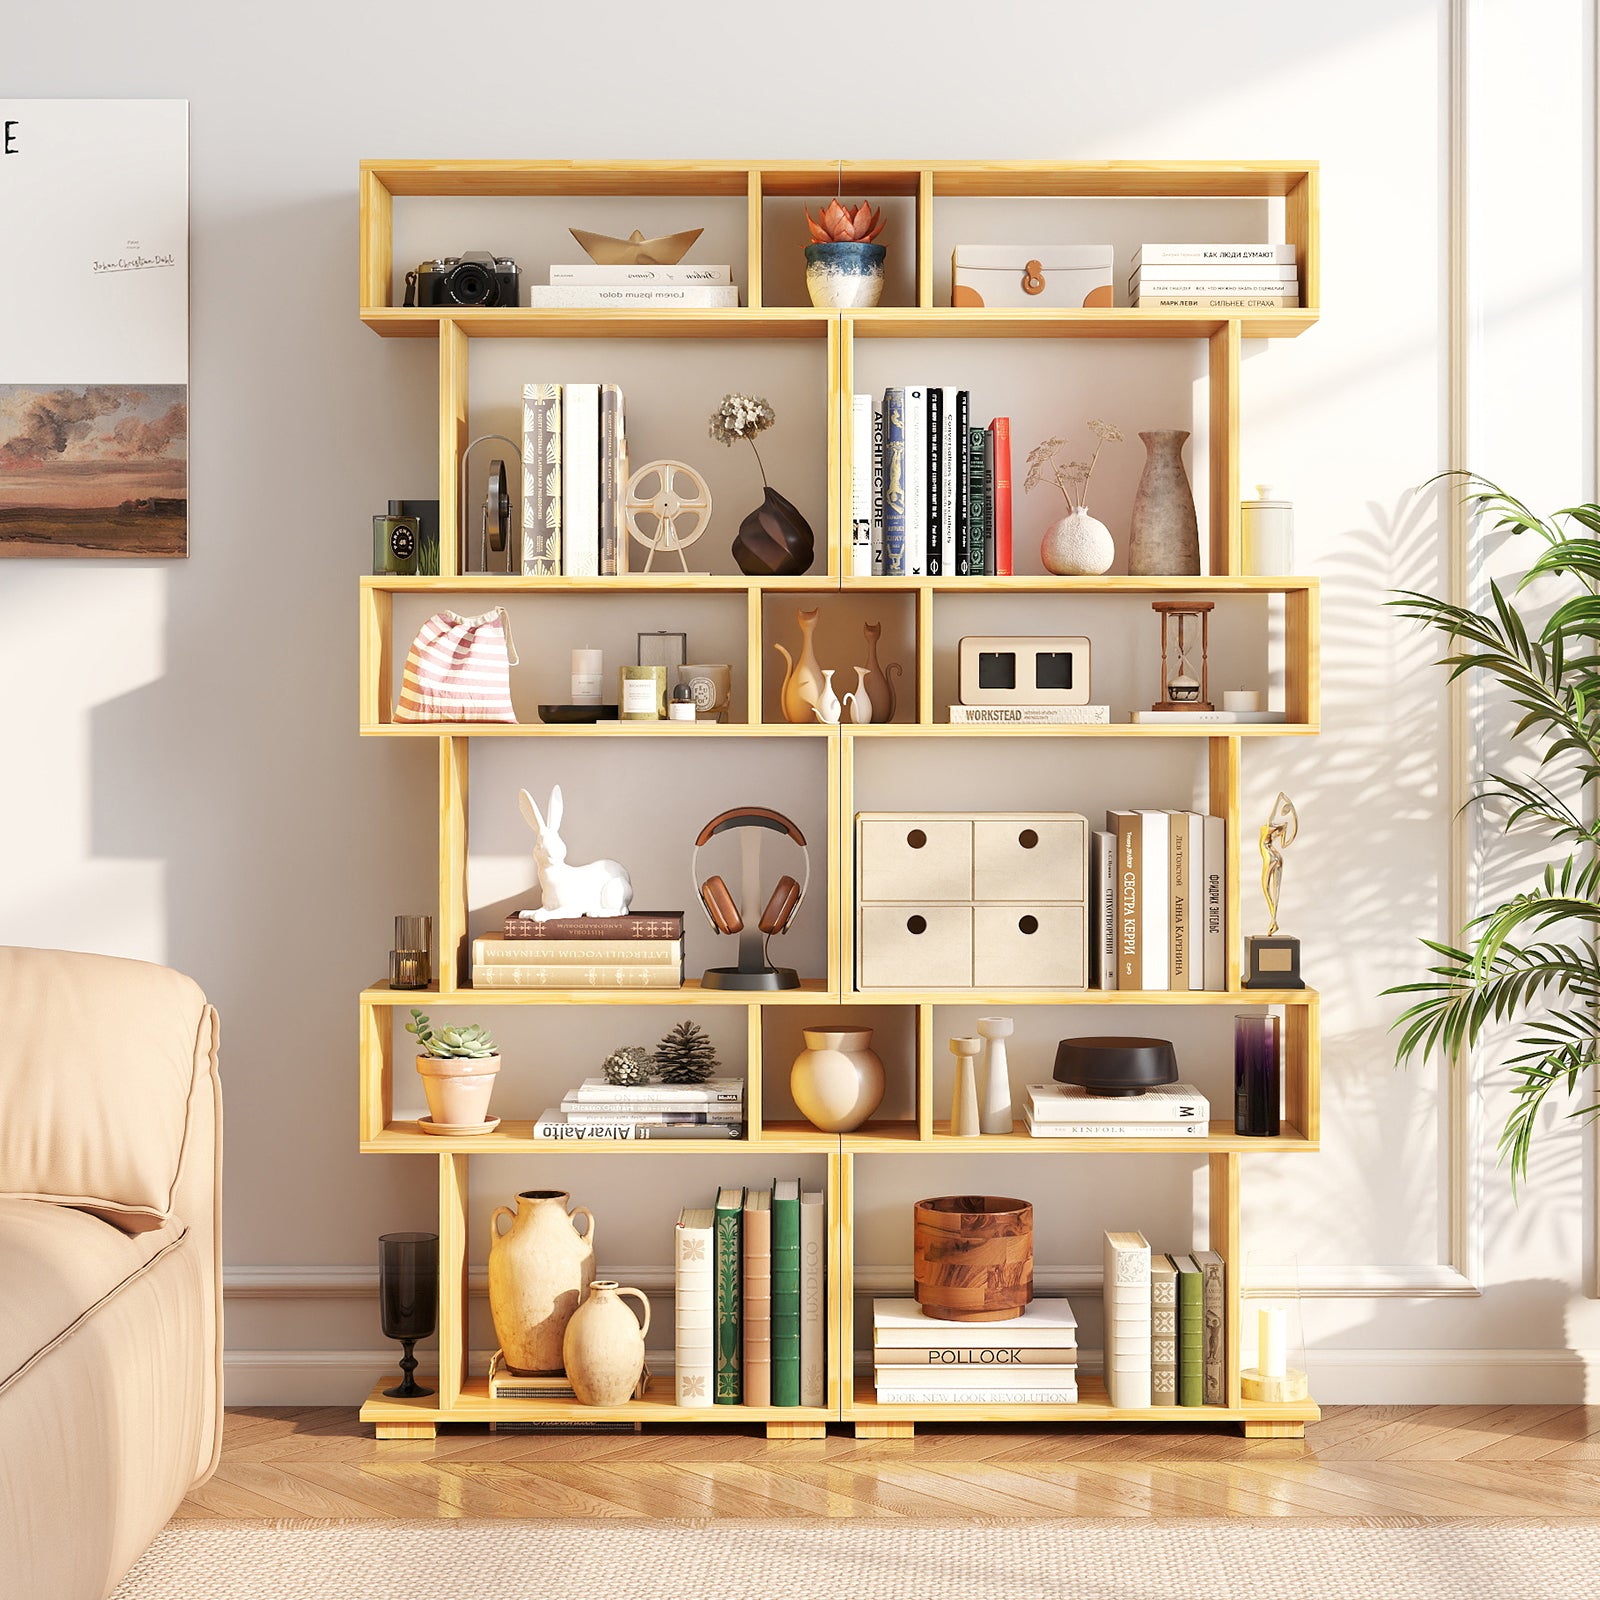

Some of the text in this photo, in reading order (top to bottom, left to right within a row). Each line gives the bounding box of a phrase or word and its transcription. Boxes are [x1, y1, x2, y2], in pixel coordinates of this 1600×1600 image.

[155, 254, 175, 264] Dahl
[874, 411, 883, 528] ARCHITECTURE
[966, 709, 1022, 721] WORKSTEAD
[1124, 872, 1136, 916] СЕСТРА
[1208, 874, 1219, 934] ФРИДРИХ ЭНГЕЛЬС
[1124, 919, 1136, 955] КЕРРИ
[486, 950, 554, 959] LATINARUM
[559, 950, 603, 959] VOCUM
[1180, 1106, 1194, 1117] M
[806, 1241, 818, 1323] LUXDECO
[929, 1349, 1022, 1364] POLLOCK
[923, 1393, 948, 1402] NEW
[953, 1393, 986, 1402] LOOK
[990, 1393, 1067, 1402] REVOLUTION
